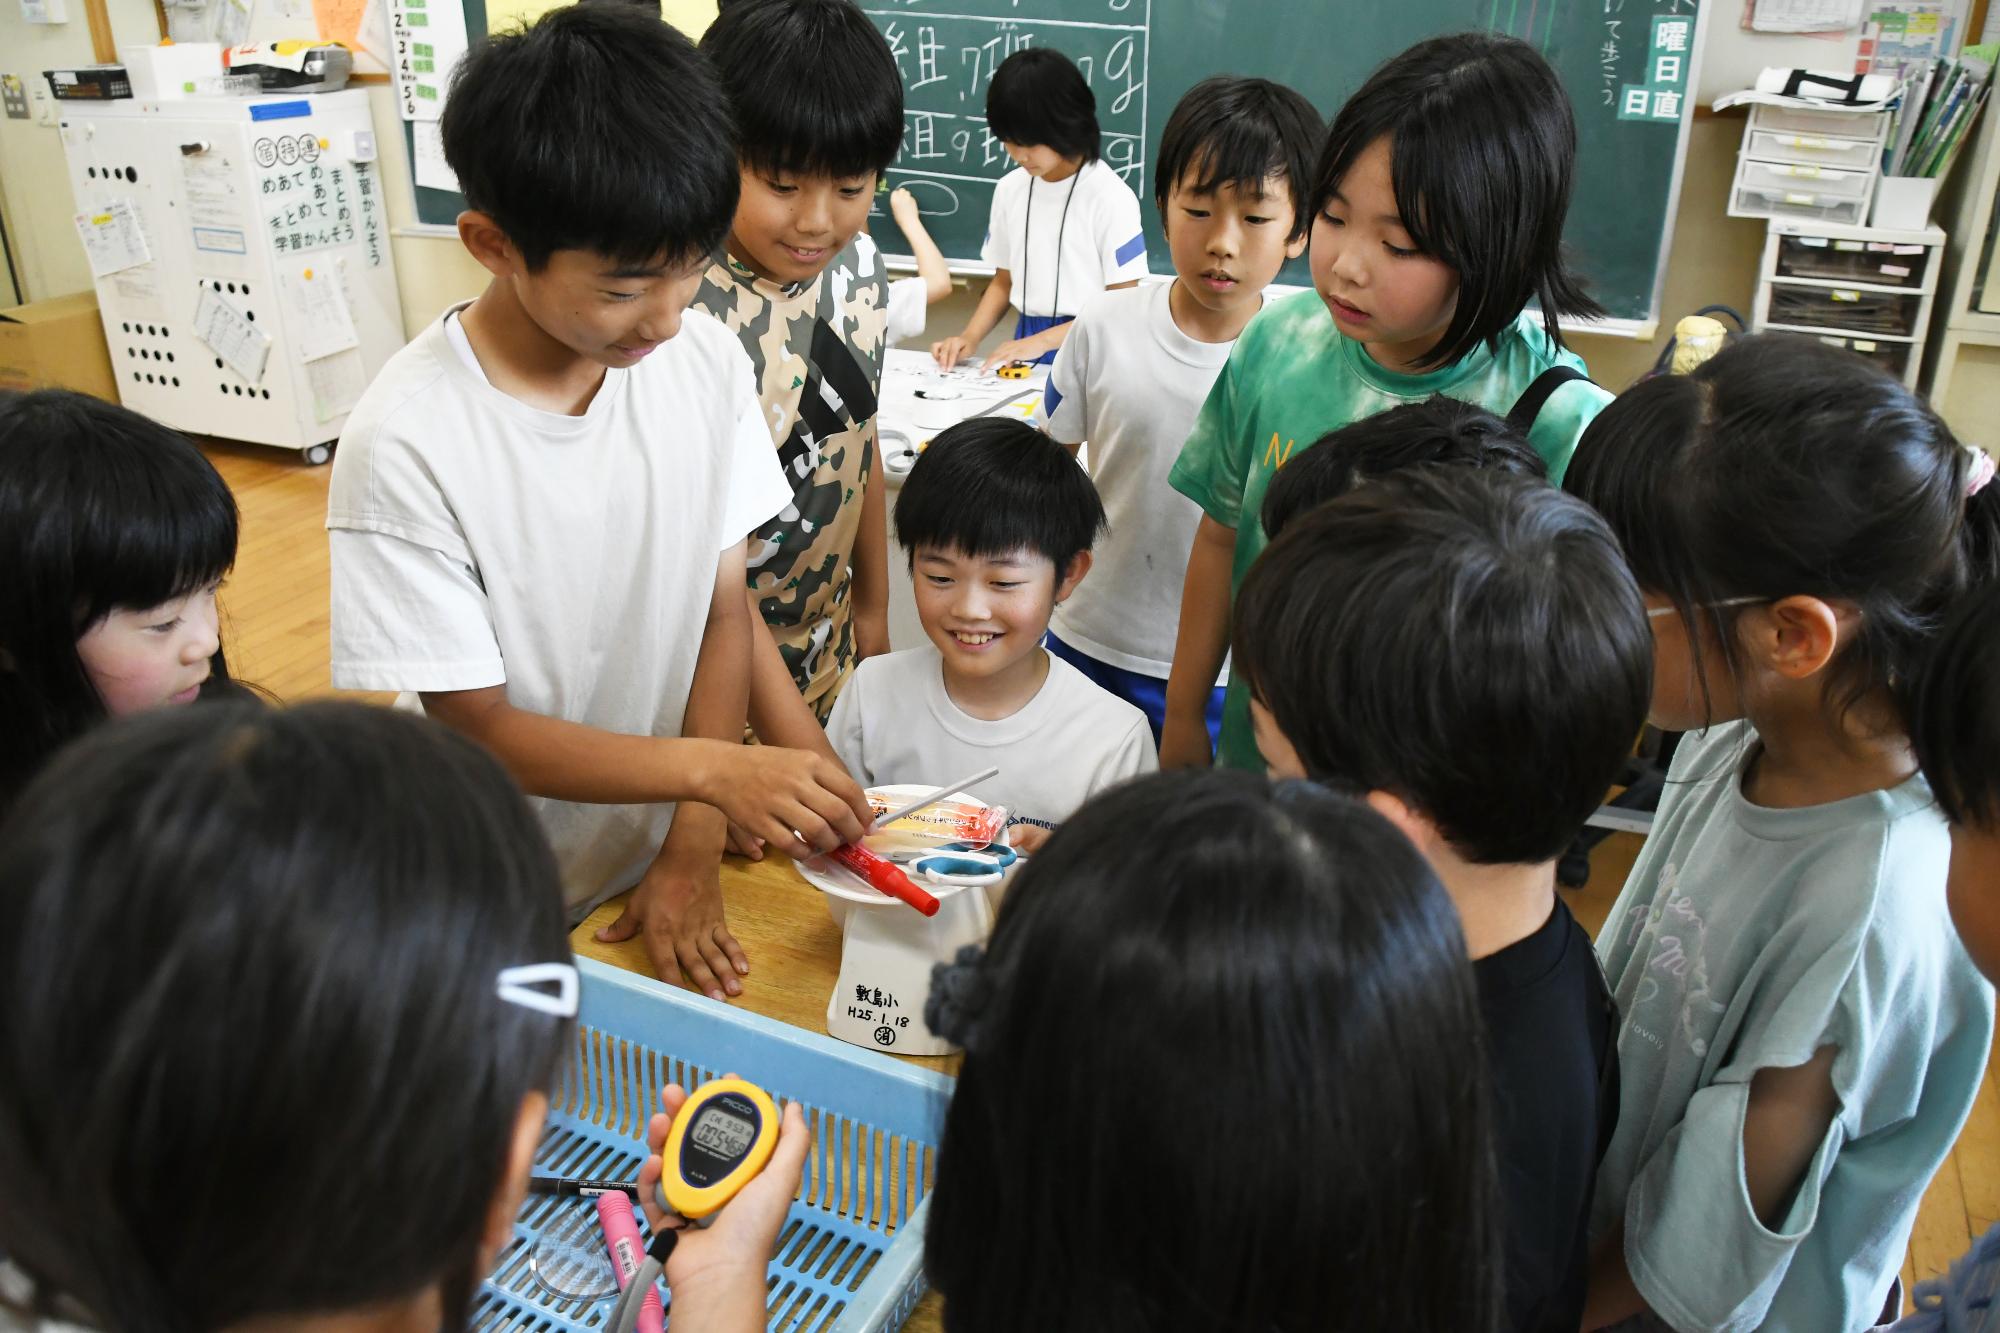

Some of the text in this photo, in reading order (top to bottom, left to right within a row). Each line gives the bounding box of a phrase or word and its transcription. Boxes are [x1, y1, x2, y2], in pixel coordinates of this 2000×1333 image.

[394, 14, 402, 28] 2
[399, 41, 406, 54] 3
[1656, 21, 1688, 83] 曜日
[401, 59, 409, 71] 4
[404, 85, 412, 99] 5
[1625, 89, 1682, 118] 日直
[407, 101, 415, 114] 6
[263, 172, 304, 194] めあて
[310, 165, 327, 217] めあて
[331, 170, 351, 220] まとめ
[270, 203, 312, 229] まとめ
[275, 223, 354, 252] 学習かんそう
[855, 984, 899, 1008] 敷島小
[721, 1096, 753, 1115] PICCO
